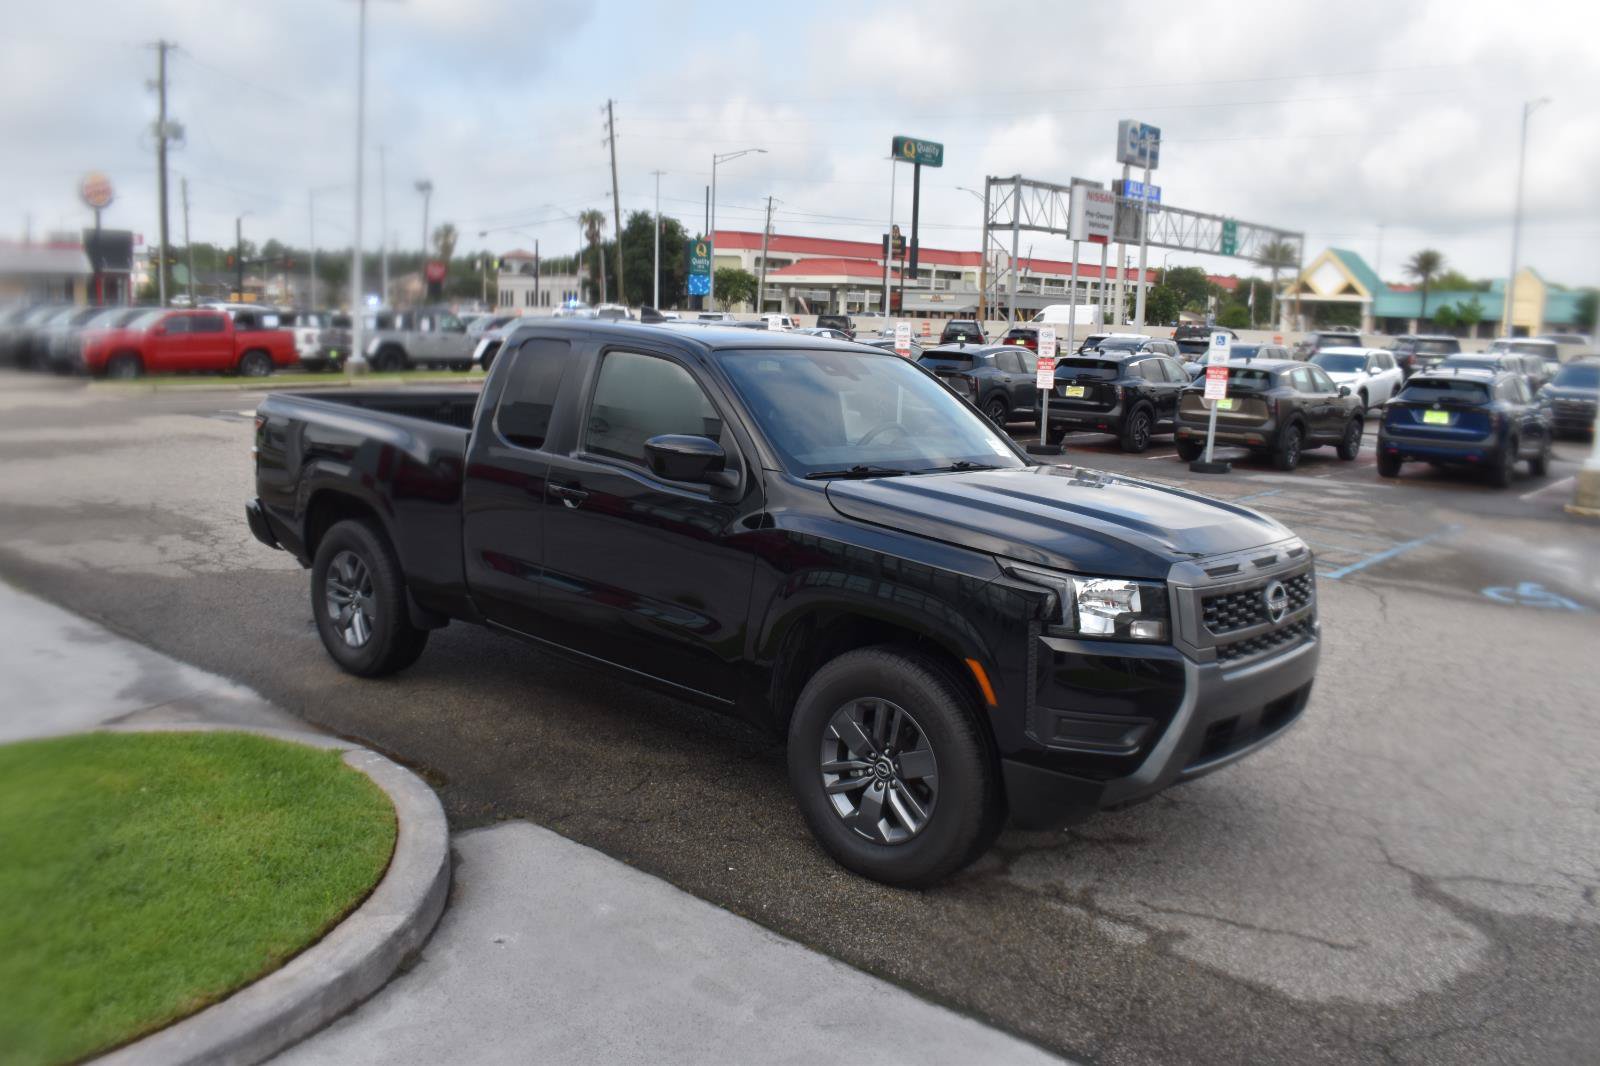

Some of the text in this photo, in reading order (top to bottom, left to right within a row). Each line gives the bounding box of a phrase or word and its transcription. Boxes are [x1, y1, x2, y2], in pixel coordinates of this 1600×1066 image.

[917, 141, 940, 157] Quality
[1087, 191, 1114, 204] NISSAN
[1085, 210, 1113, 221] Pre-Owned
[691, 257, 710, 266] Quality
